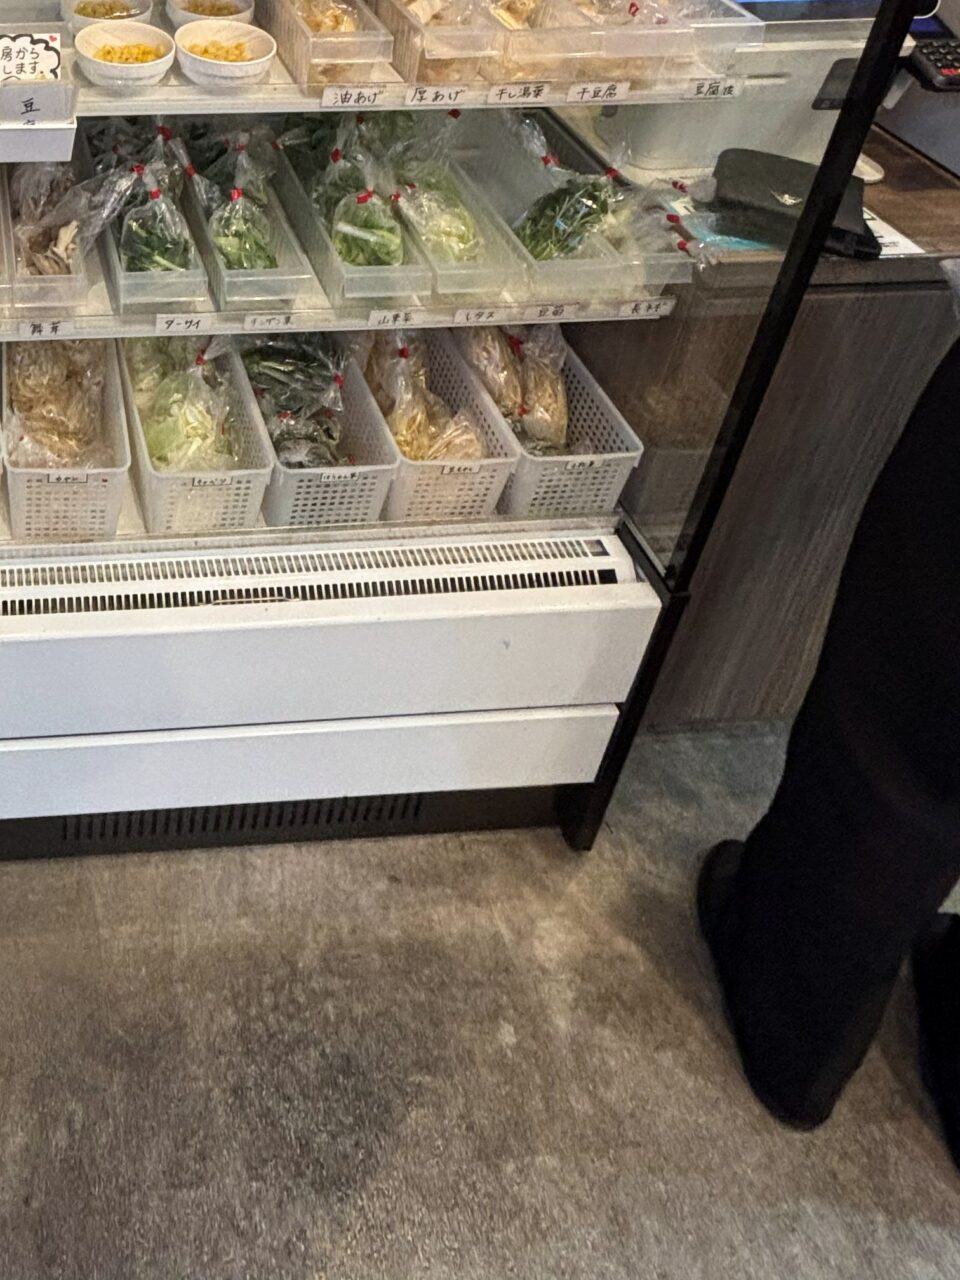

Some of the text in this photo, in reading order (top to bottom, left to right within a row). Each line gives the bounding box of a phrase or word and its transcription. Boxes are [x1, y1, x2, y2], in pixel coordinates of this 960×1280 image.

[334, 89, 385, 106] 油あげ
[411, 86, 466, 105] 厚あげ
[577, 83, 618, 102] 干豆腐
